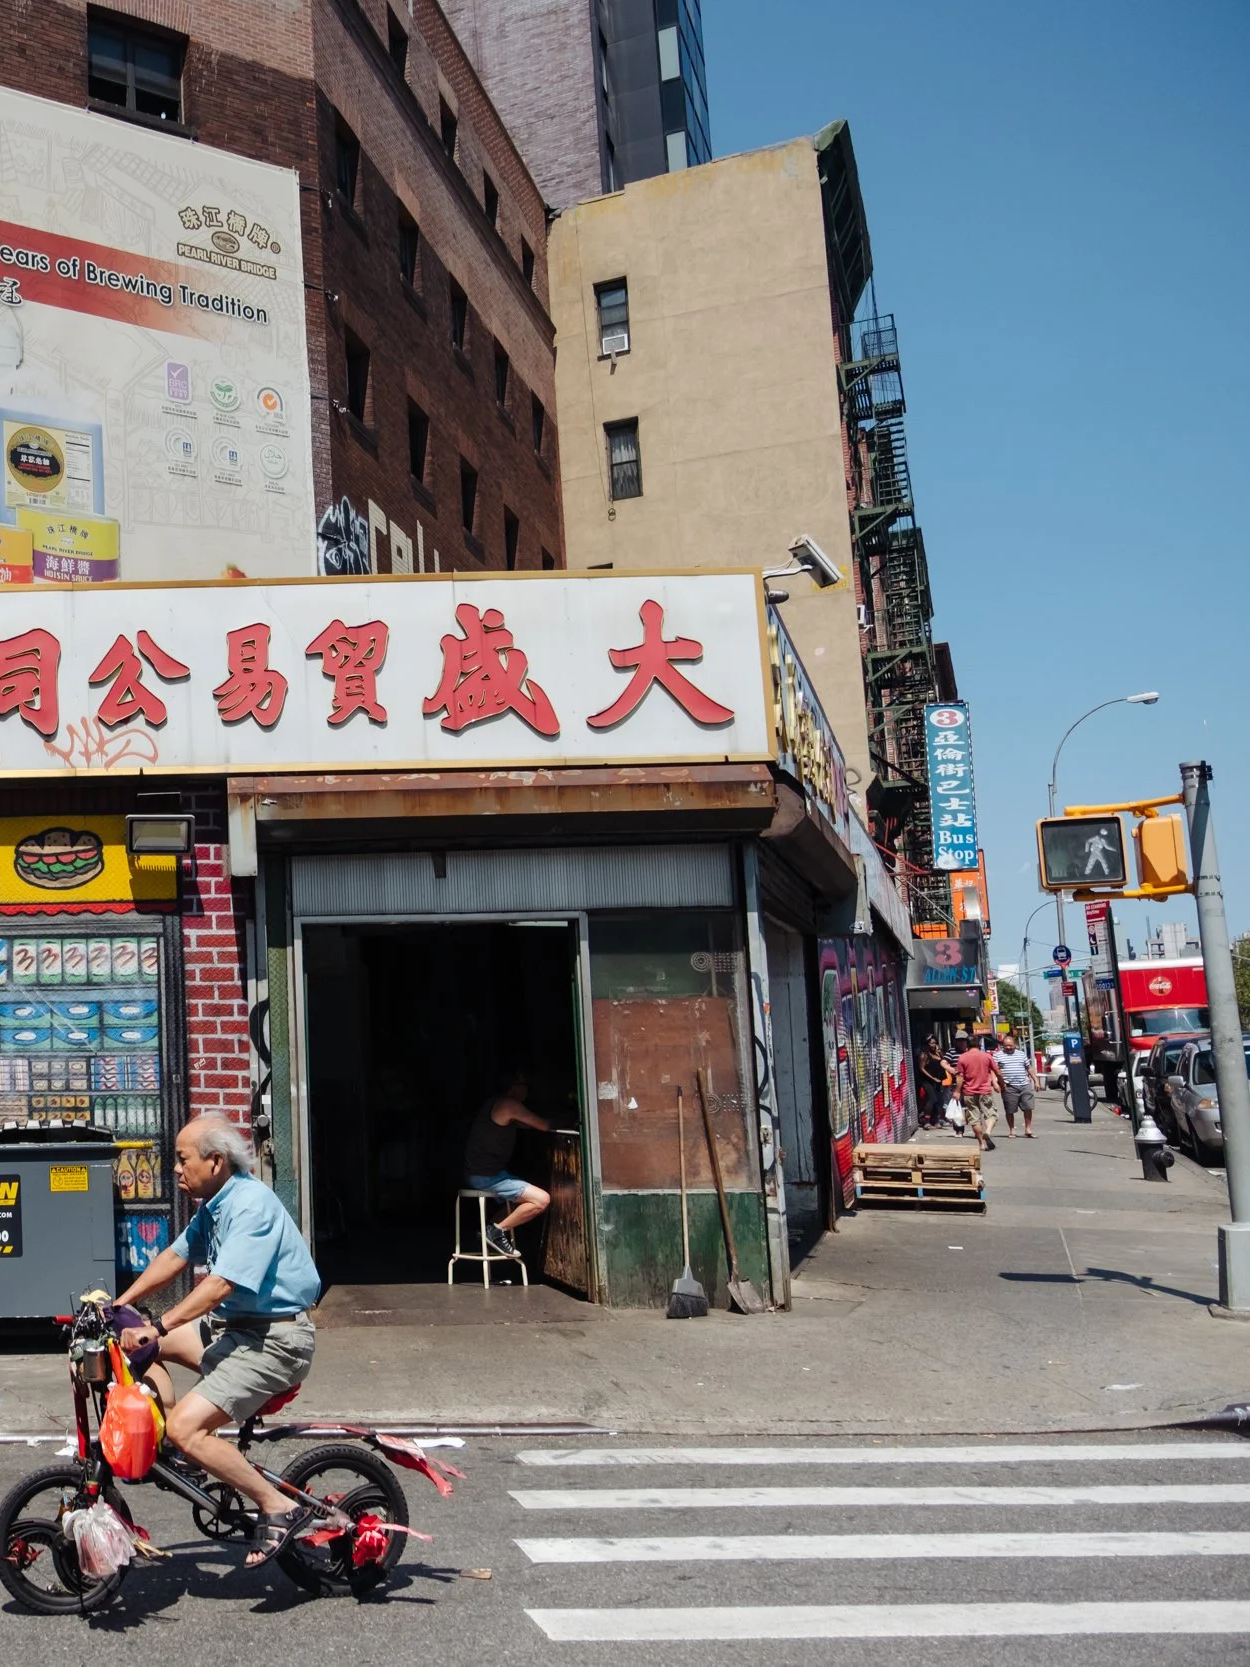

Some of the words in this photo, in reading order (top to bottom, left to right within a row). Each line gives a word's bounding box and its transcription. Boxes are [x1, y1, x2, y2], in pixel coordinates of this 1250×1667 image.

[177, 243, 210, 262] PEARL
[210, 251, 240, 270] RIVER
[240, 260, 277, 280] BRIDGE
[57, 257, 80, 278] of
[85, 264, 174, 304] Brewing
[178, 284, 269, 324] Tradition
[42, 544, 57, 552] PEARL
[59, 547, 75, 555] RIVER
[44, 569, 70, 582] HOISIN
[71, 574, 93, 583] SAUCE
[936, 710, 958, 727] 3
[933, 731, 973, 827] 亞倫街巴士站
[938, 830, 975, 845] Bus
[938, 846, 975, 865] Stop
[935, 940, 963, 966] 3
[925, 967, 958, 984] ALLEN
[961, 966, 977, 983] ST
[1071, 1039, 1078, 1048] P
